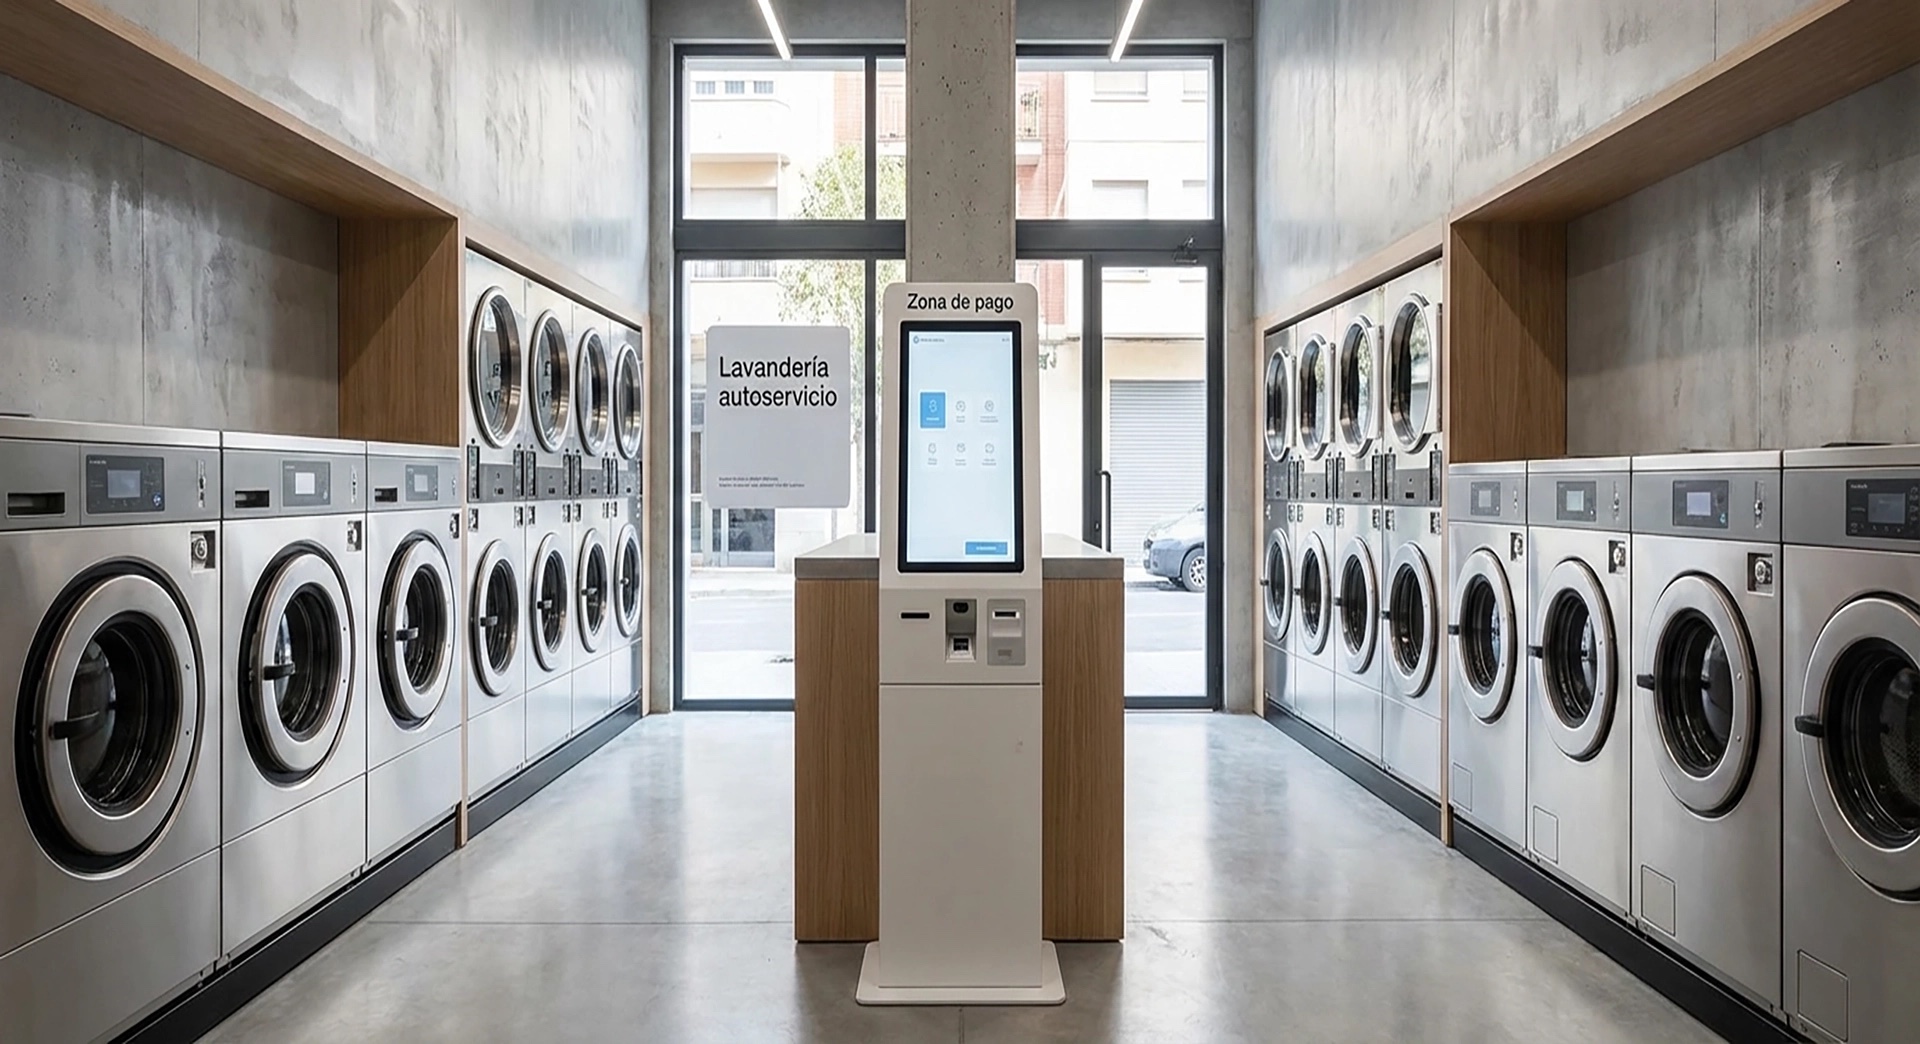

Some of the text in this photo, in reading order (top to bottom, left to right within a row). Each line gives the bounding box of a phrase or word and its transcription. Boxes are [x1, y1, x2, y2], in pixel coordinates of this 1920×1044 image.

[907, 292, 1015, 314] Zona de pago
[719, 355, 830, 378] Lavandería
[719, 384, 838, 407] autoservicio
